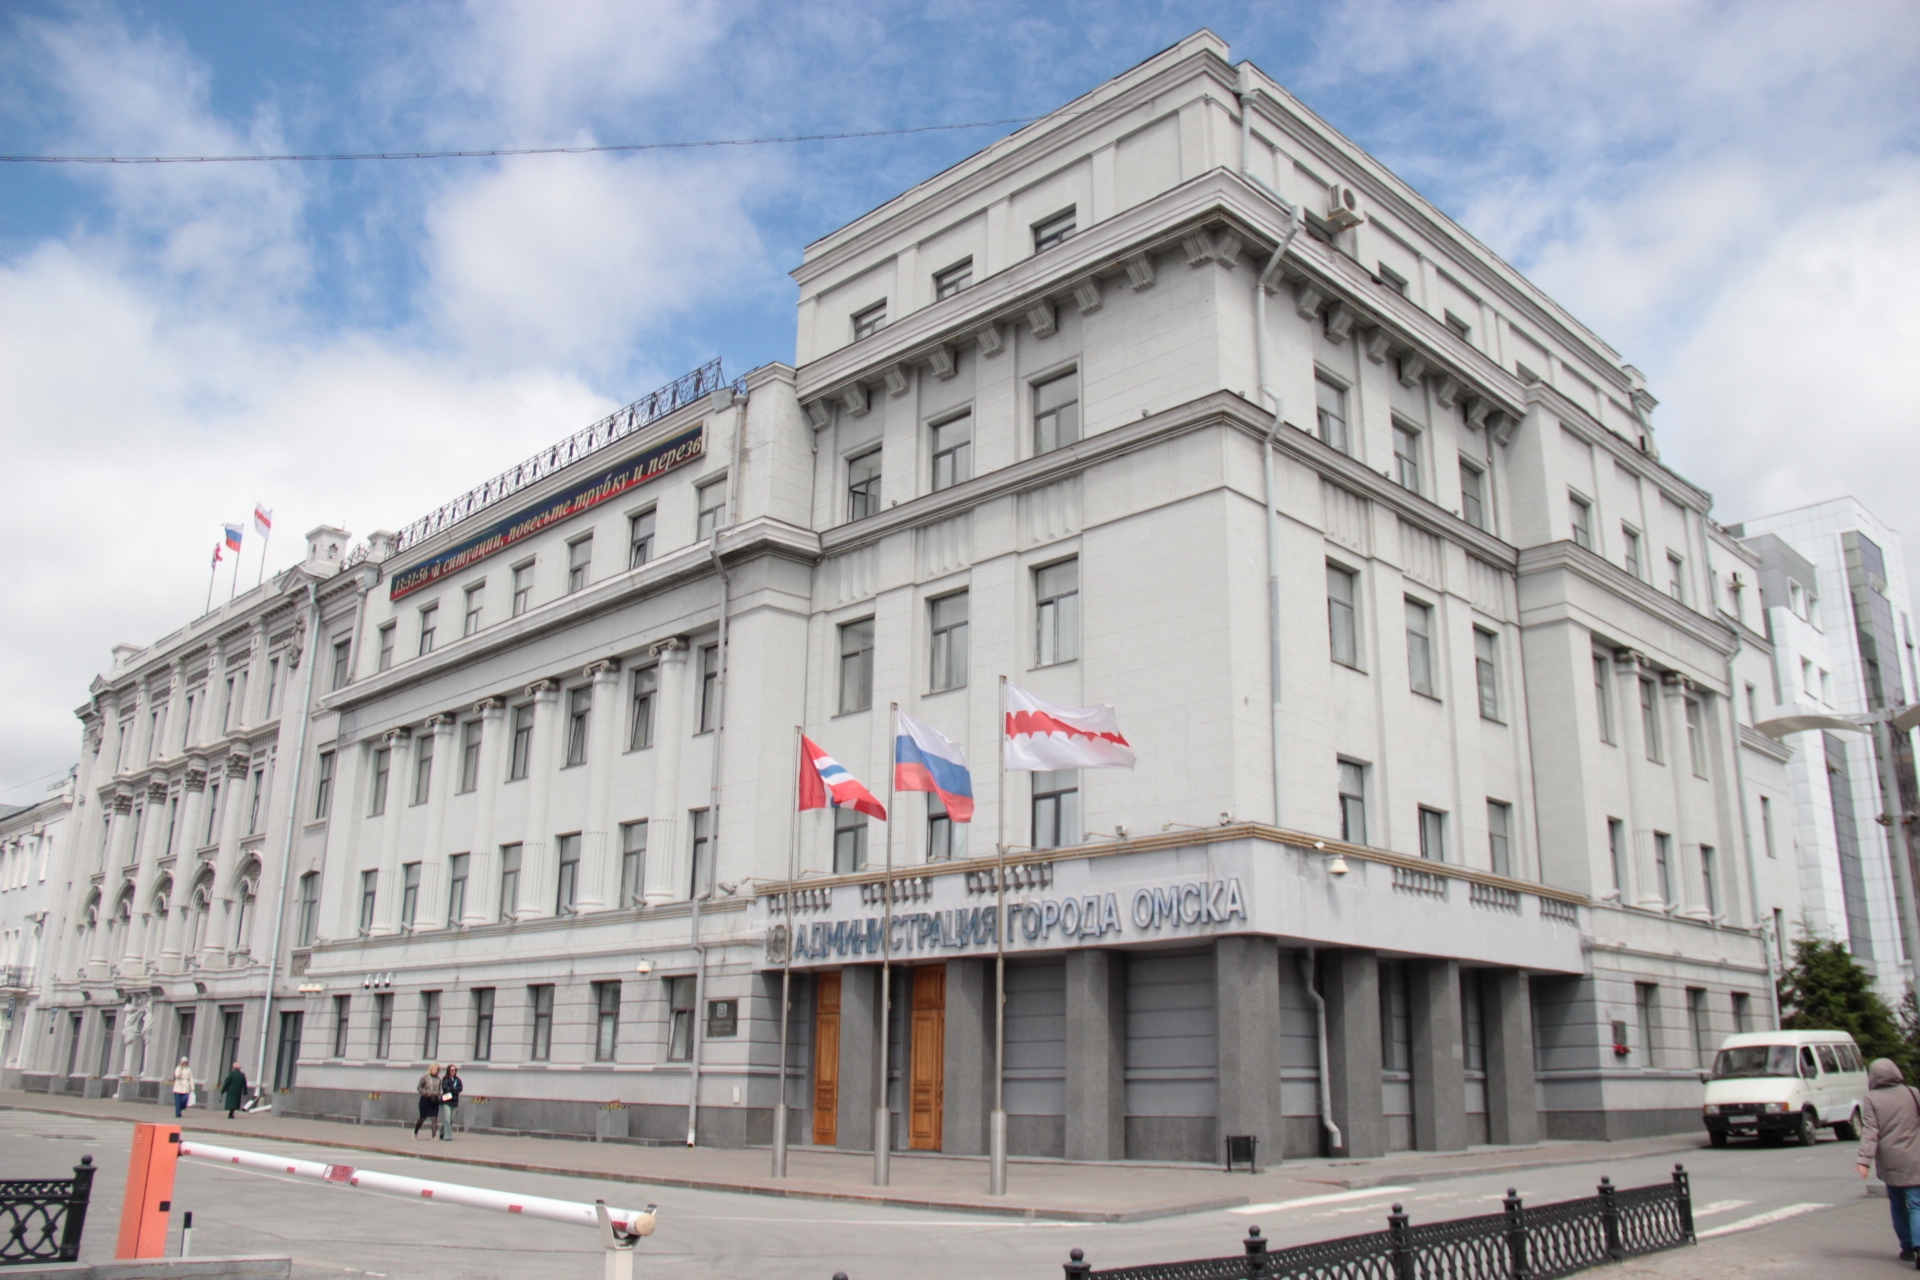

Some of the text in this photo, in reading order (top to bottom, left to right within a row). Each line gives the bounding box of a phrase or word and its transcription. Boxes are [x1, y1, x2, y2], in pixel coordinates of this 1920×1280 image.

[442, 533, 504, 573] ситуации,
[507, 499, 571, 542] повесьте
[573, 472, 630, 509] трубку
[632, 463, 644, 483] и
[794, 877, 1247, 959] АДМИНИСТРАЦИЯ ГОРОДА ОМСКА
